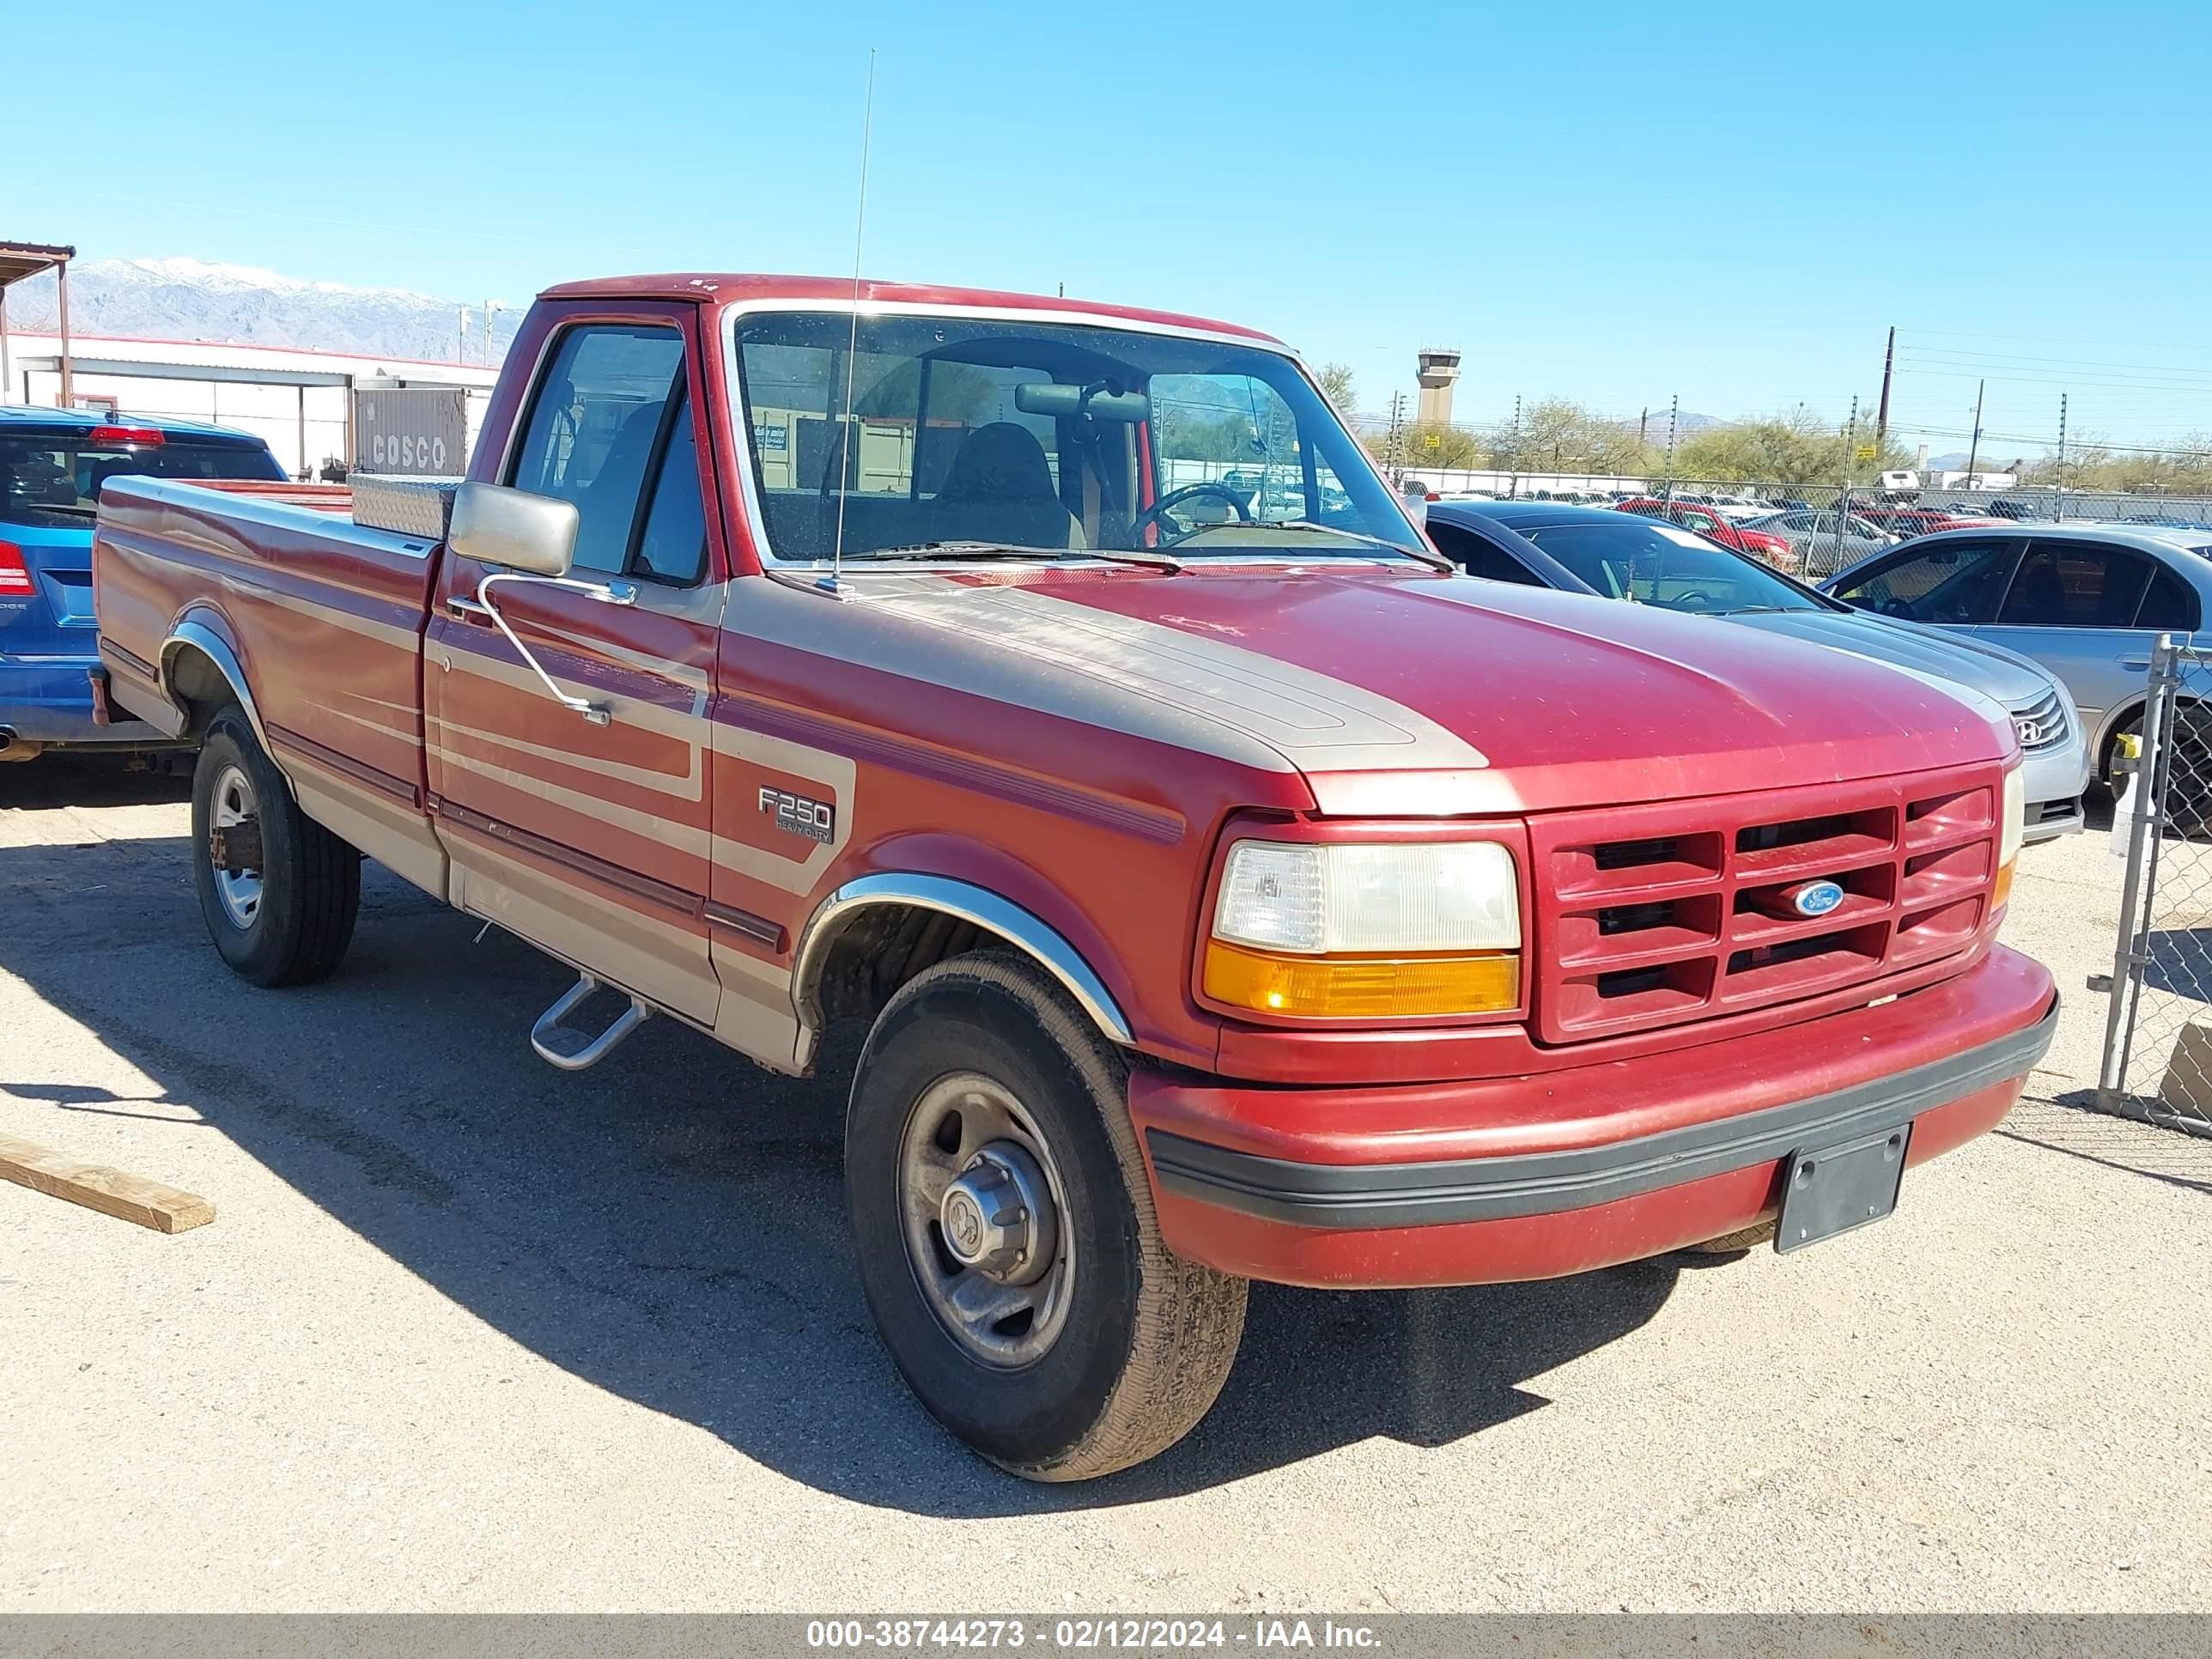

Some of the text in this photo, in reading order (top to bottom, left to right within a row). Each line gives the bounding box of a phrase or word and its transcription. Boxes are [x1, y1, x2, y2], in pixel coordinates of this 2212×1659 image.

[374, 434, 446, 470] COSCO
[776, 820, 830, 842] HEAVY DUTY
